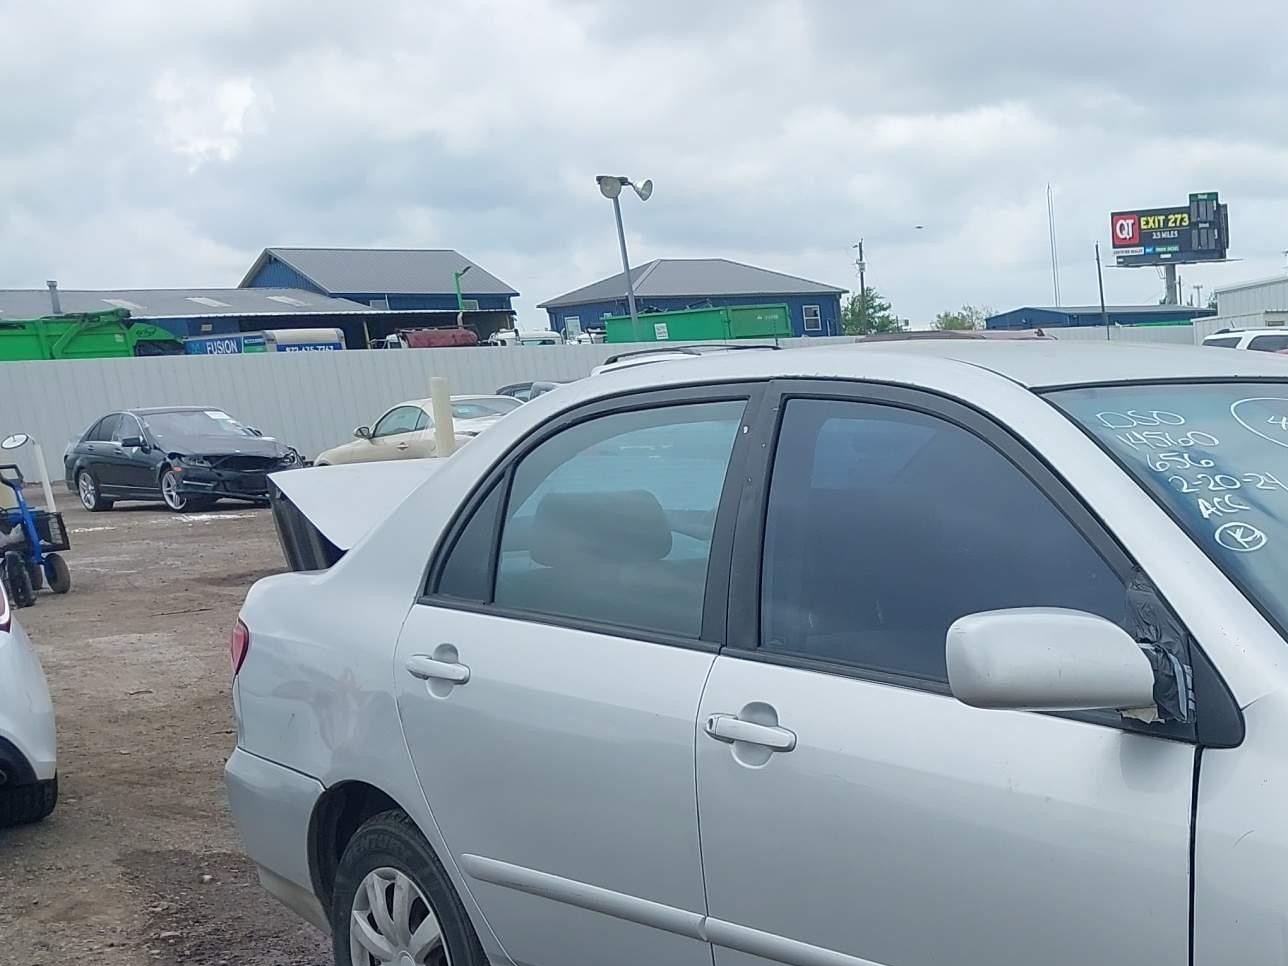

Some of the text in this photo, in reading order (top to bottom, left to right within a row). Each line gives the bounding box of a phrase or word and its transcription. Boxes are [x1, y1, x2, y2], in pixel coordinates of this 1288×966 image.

[1140, 214, 1189, 229] EXIT 273
[1116, 219, 1135, 240] QT
[1161, 230, 1178, 238] MILES
[206, 340, 238, 354] FUSION
[1146, 452, 1215, 472] 656
